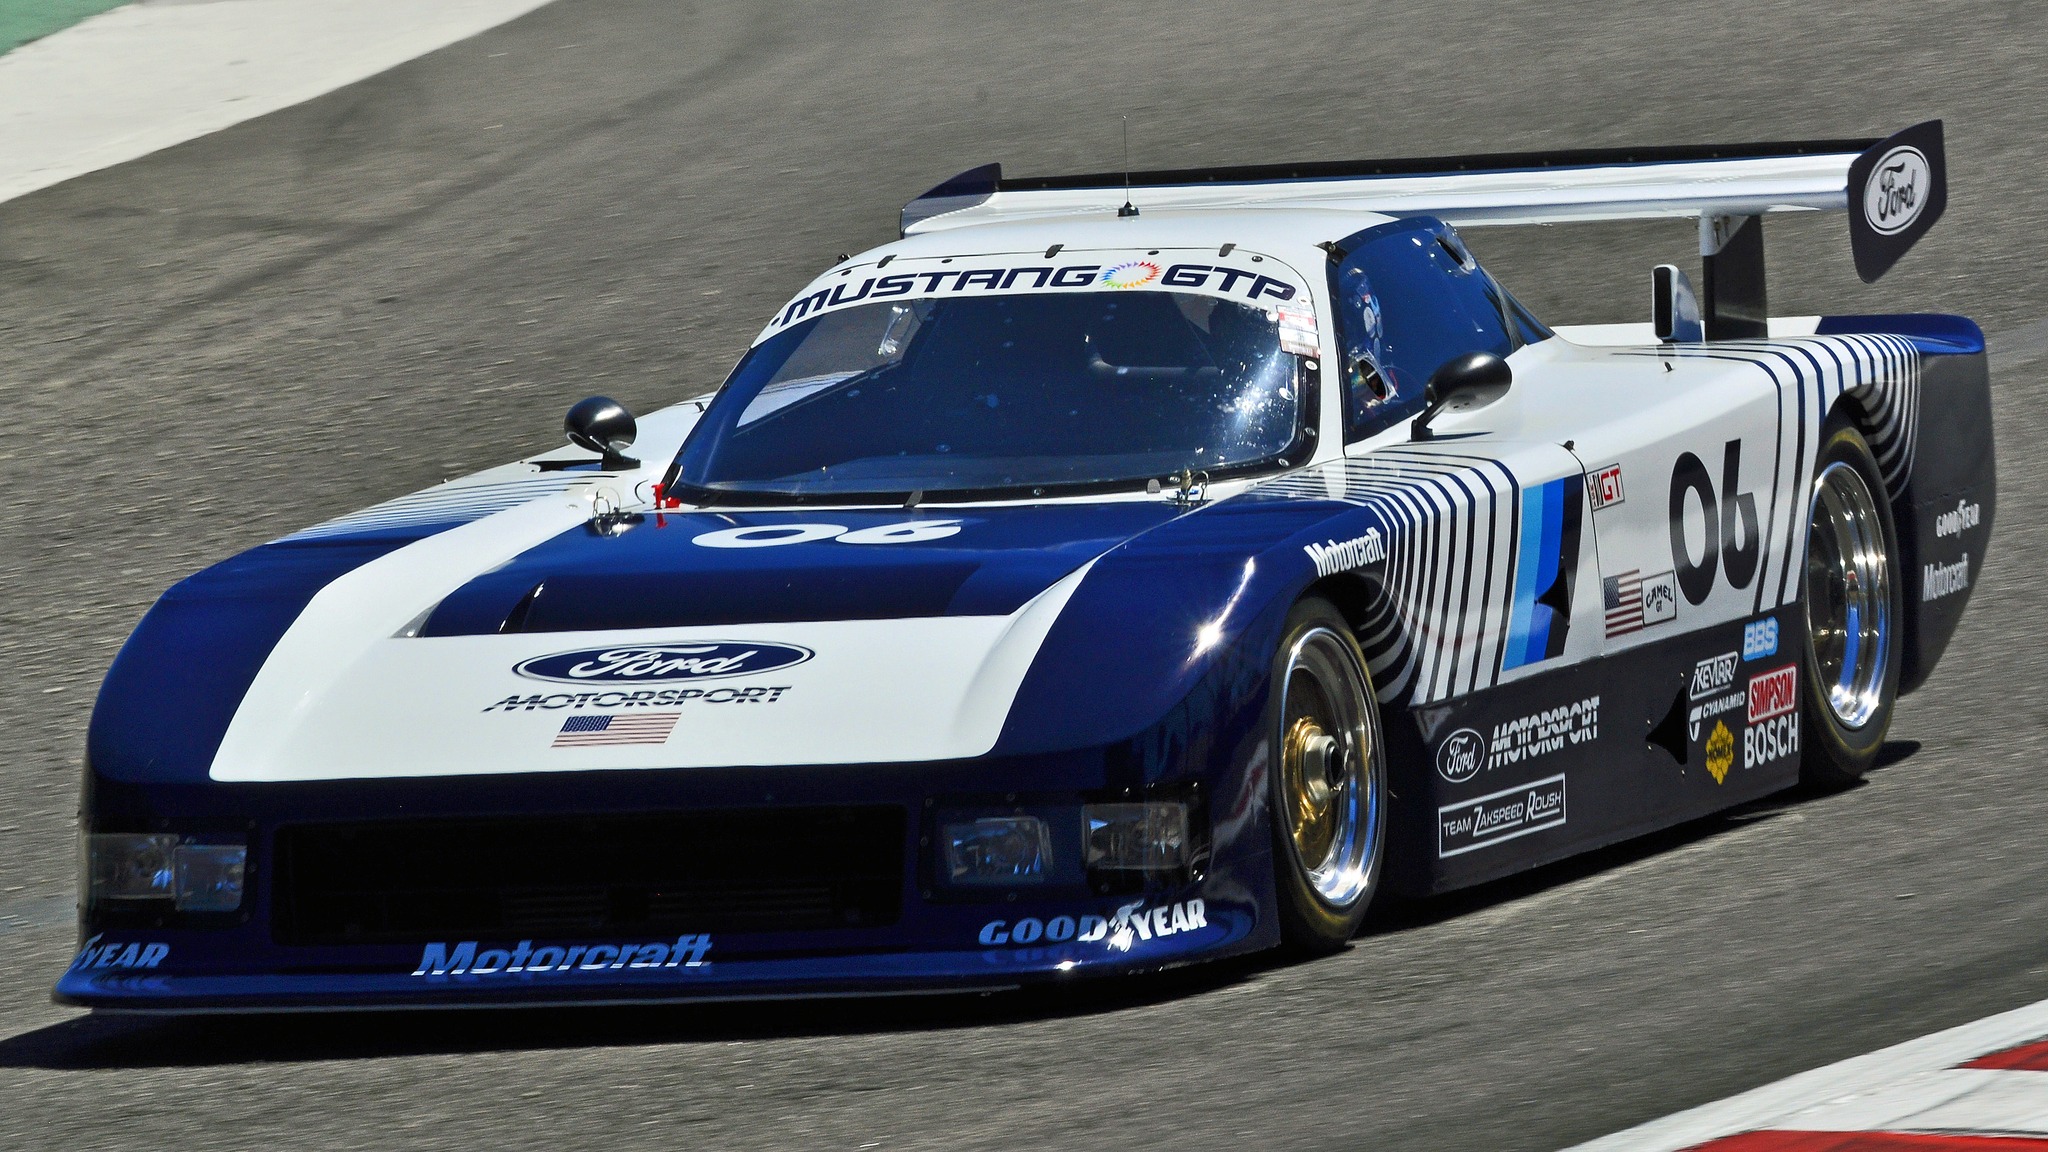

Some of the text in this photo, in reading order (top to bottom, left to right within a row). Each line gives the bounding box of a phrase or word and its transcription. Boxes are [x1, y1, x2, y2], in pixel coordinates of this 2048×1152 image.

[1878, 161, 1917, 222] Ford
[779, 264, 1296, 327] MUSTANG GTP
[1601, 467, 1620, 501] GT
[691, 519, 964, 549] 06
[1669, 438, 1759, 606] 06
[1302, 526, 1386, 578] Motorcraft
[1645, 584, 1674, 608] CAMEL
[1922, 551, 1969, 602] Motorcraft
[568, 645, 758, 678] Ford
[1743, 617, 1779, 661] BBS
[1695, 656, 1734, 693] KEVLAR
[1750, 674, 1794, 719] SIMPSON
[481, 685, 793, 713] MOTORSPORT
[1702, 690, 1746, 719] CYANAMID
[1446, 697, 1600, 776] Ford MOTORSPORT
[1744, 711, 1799, 770] BOSCH
[1443, 791, 1563, 838] TEAM ZAKSPEED ROUSH
[978, 899, 1208, 950] GOODYEAR
[410, 933, 713, 977] Motorcraft
